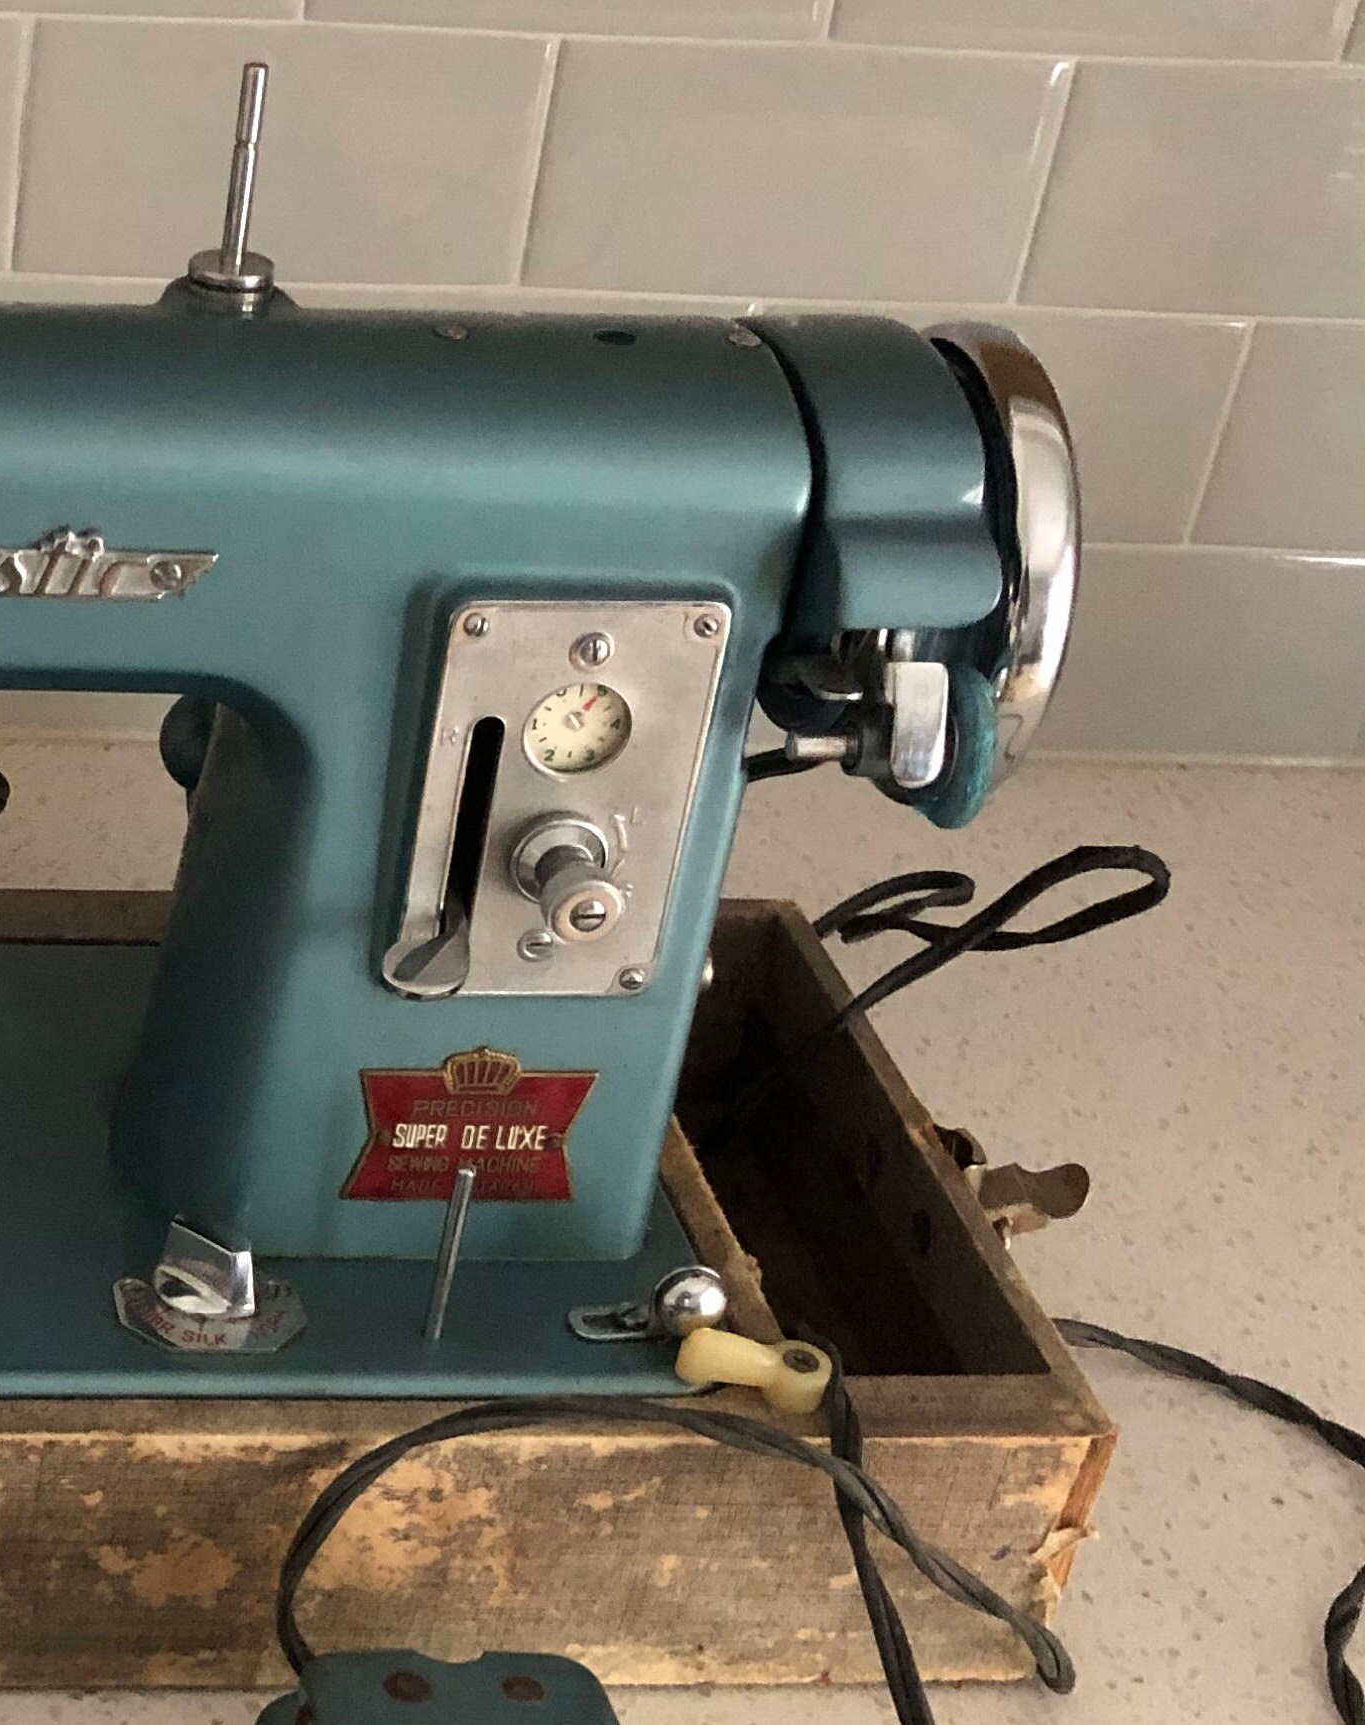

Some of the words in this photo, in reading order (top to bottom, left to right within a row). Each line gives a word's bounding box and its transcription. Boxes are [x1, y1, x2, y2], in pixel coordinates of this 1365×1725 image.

[544, 749, 555, 761] 2
[410, 1100, 539, 1118] PRECISION
[392, 1123, 448, 1149] SUPER
[461, 1125, 490, 1150] DE
[496, 1125, 548, 1151] LUXE
[182, 1330, 228, 1346] SILK
